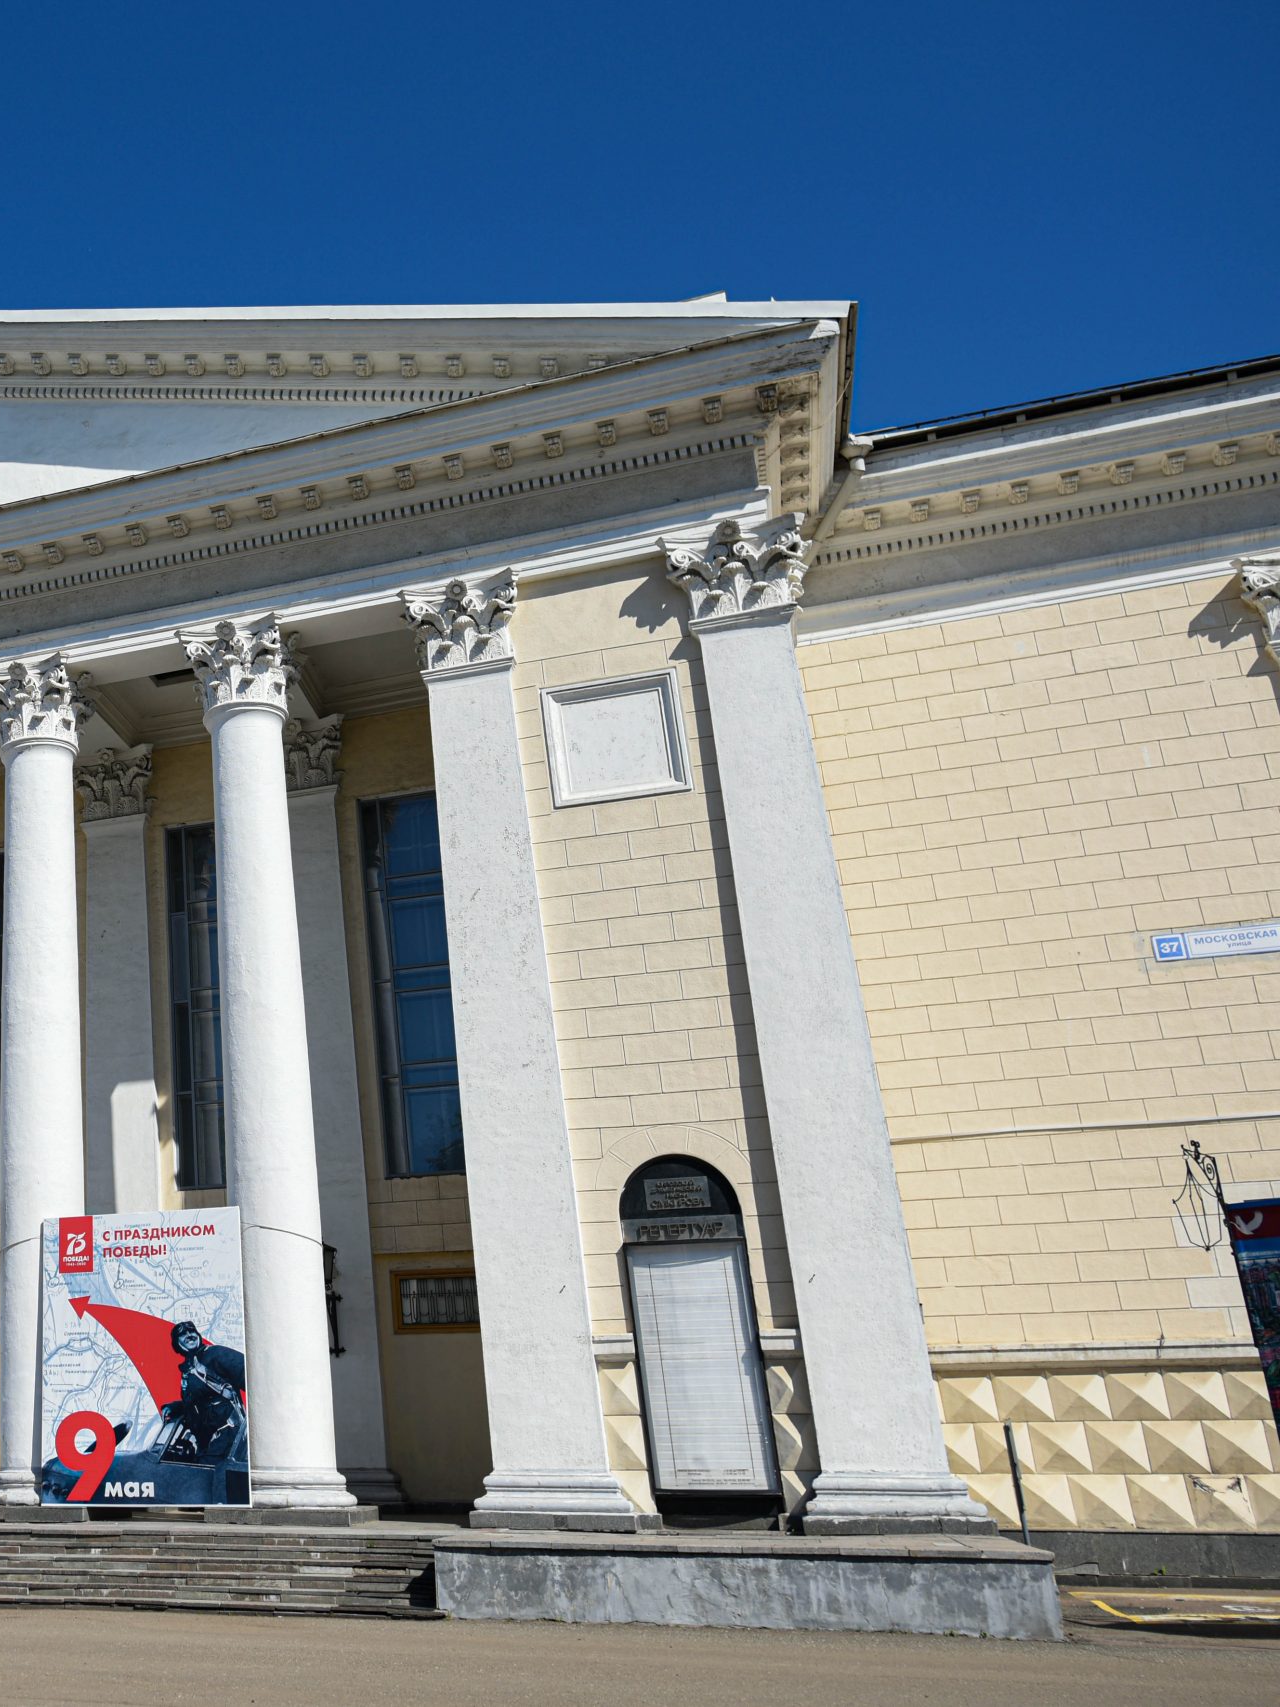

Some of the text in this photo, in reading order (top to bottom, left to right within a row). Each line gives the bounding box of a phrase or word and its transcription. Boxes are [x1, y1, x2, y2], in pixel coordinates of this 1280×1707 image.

[1194, 929, 1278, 945] МОСКОВСКАЯ
[1160, 941, 1180, 954] 37
[102, 1224, 215, 1242] С ПРАЗДНИКОМ
[639, 1222, 723, 1239] РЕПЕРТУАР
[102, 1244, 167, 1259] ПОБЕДЫ!
[55, 1411, 116, 1501] 9
[105, 1481, 154, 1497] мая
